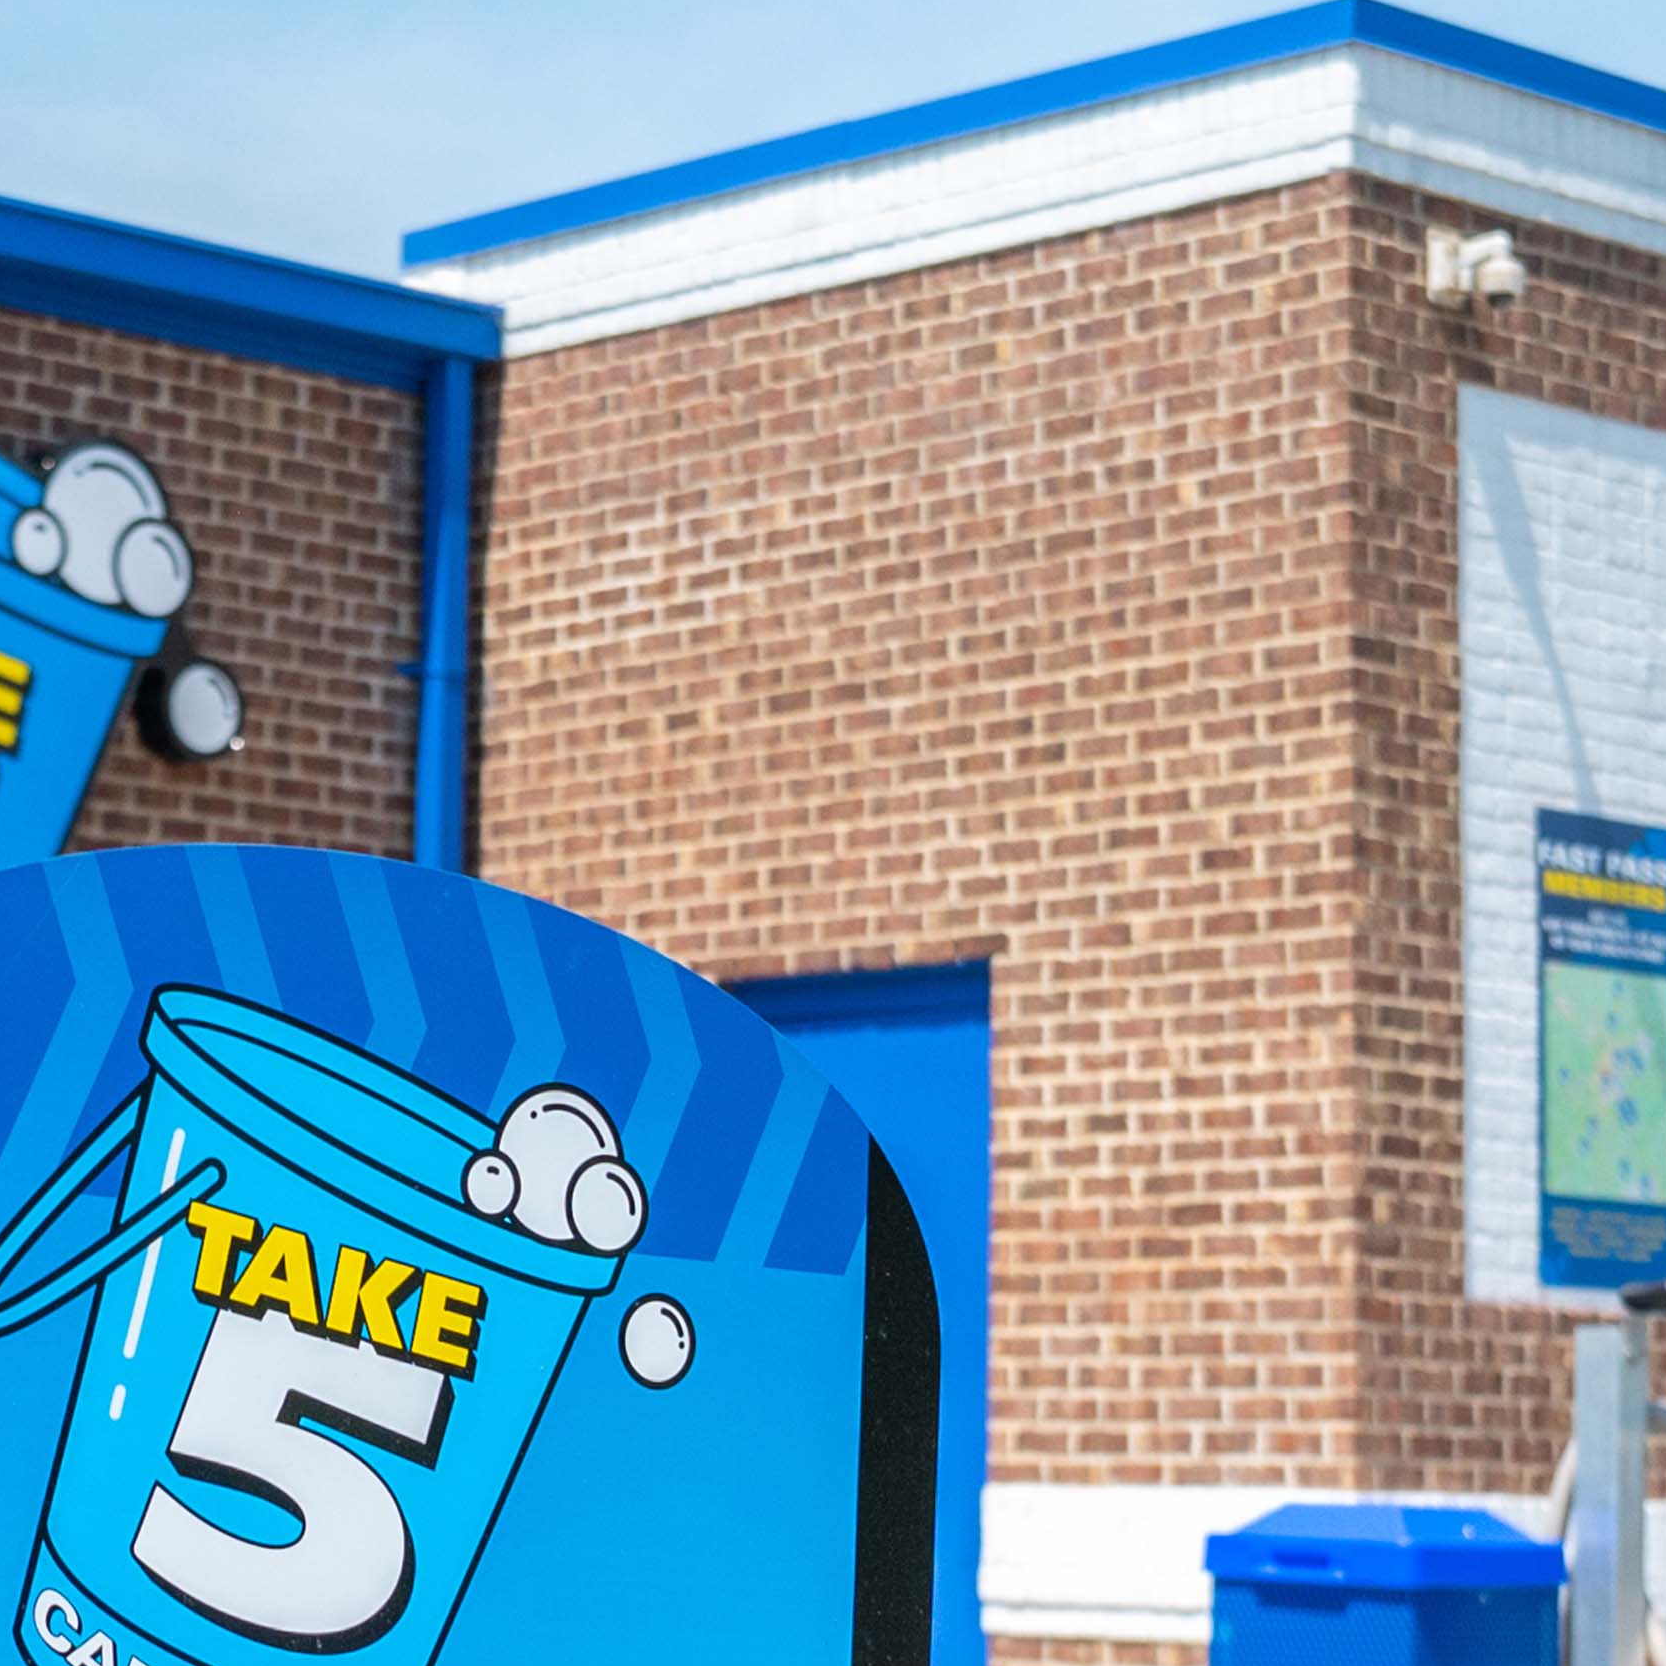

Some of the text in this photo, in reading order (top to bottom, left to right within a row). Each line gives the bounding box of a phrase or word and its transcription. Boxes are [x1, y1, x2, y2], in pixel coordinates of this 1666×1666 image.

[1537, 838, 1601, 875] FAST
[187, 1199, 488, 1382] TAKE
[130, 1307, 455, 1656] 5
